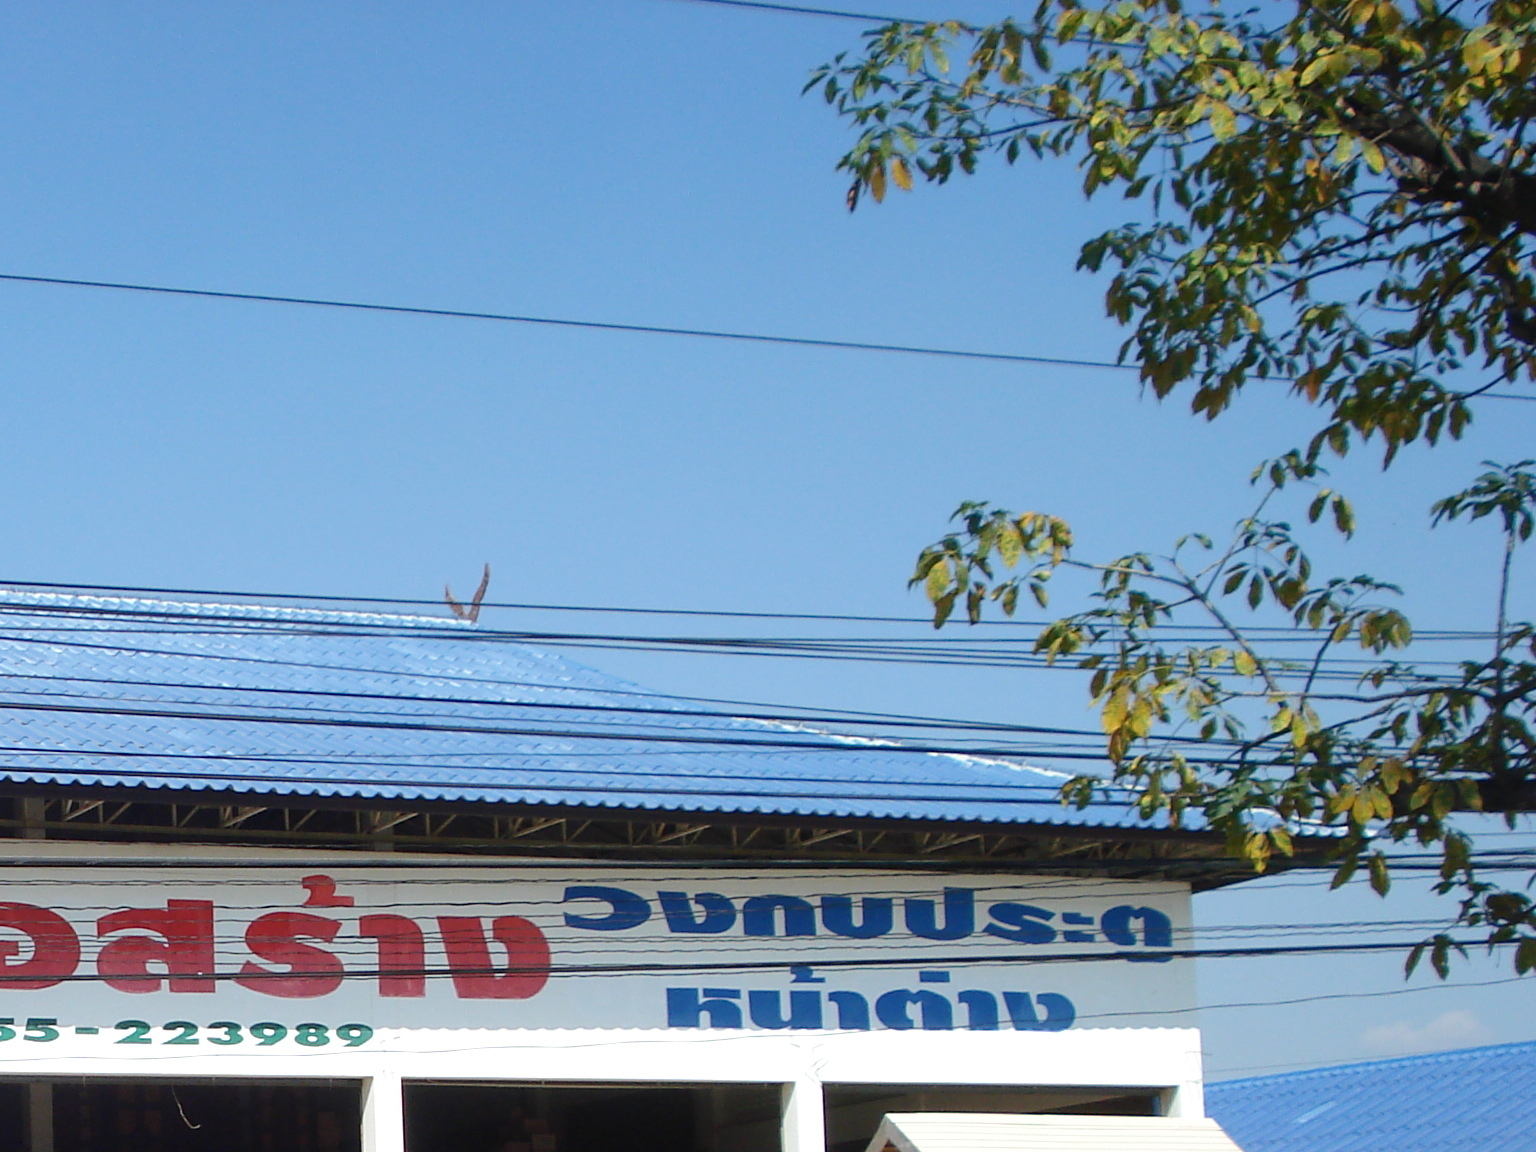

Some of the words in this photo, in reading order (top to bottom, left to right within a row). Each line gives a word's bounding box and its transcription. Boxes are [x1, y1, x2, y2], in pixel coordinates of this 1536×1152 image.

[564, 887, 1173, 962] วงกบประตู
[666, 966, 1076, 1032] หน้าต่าง
